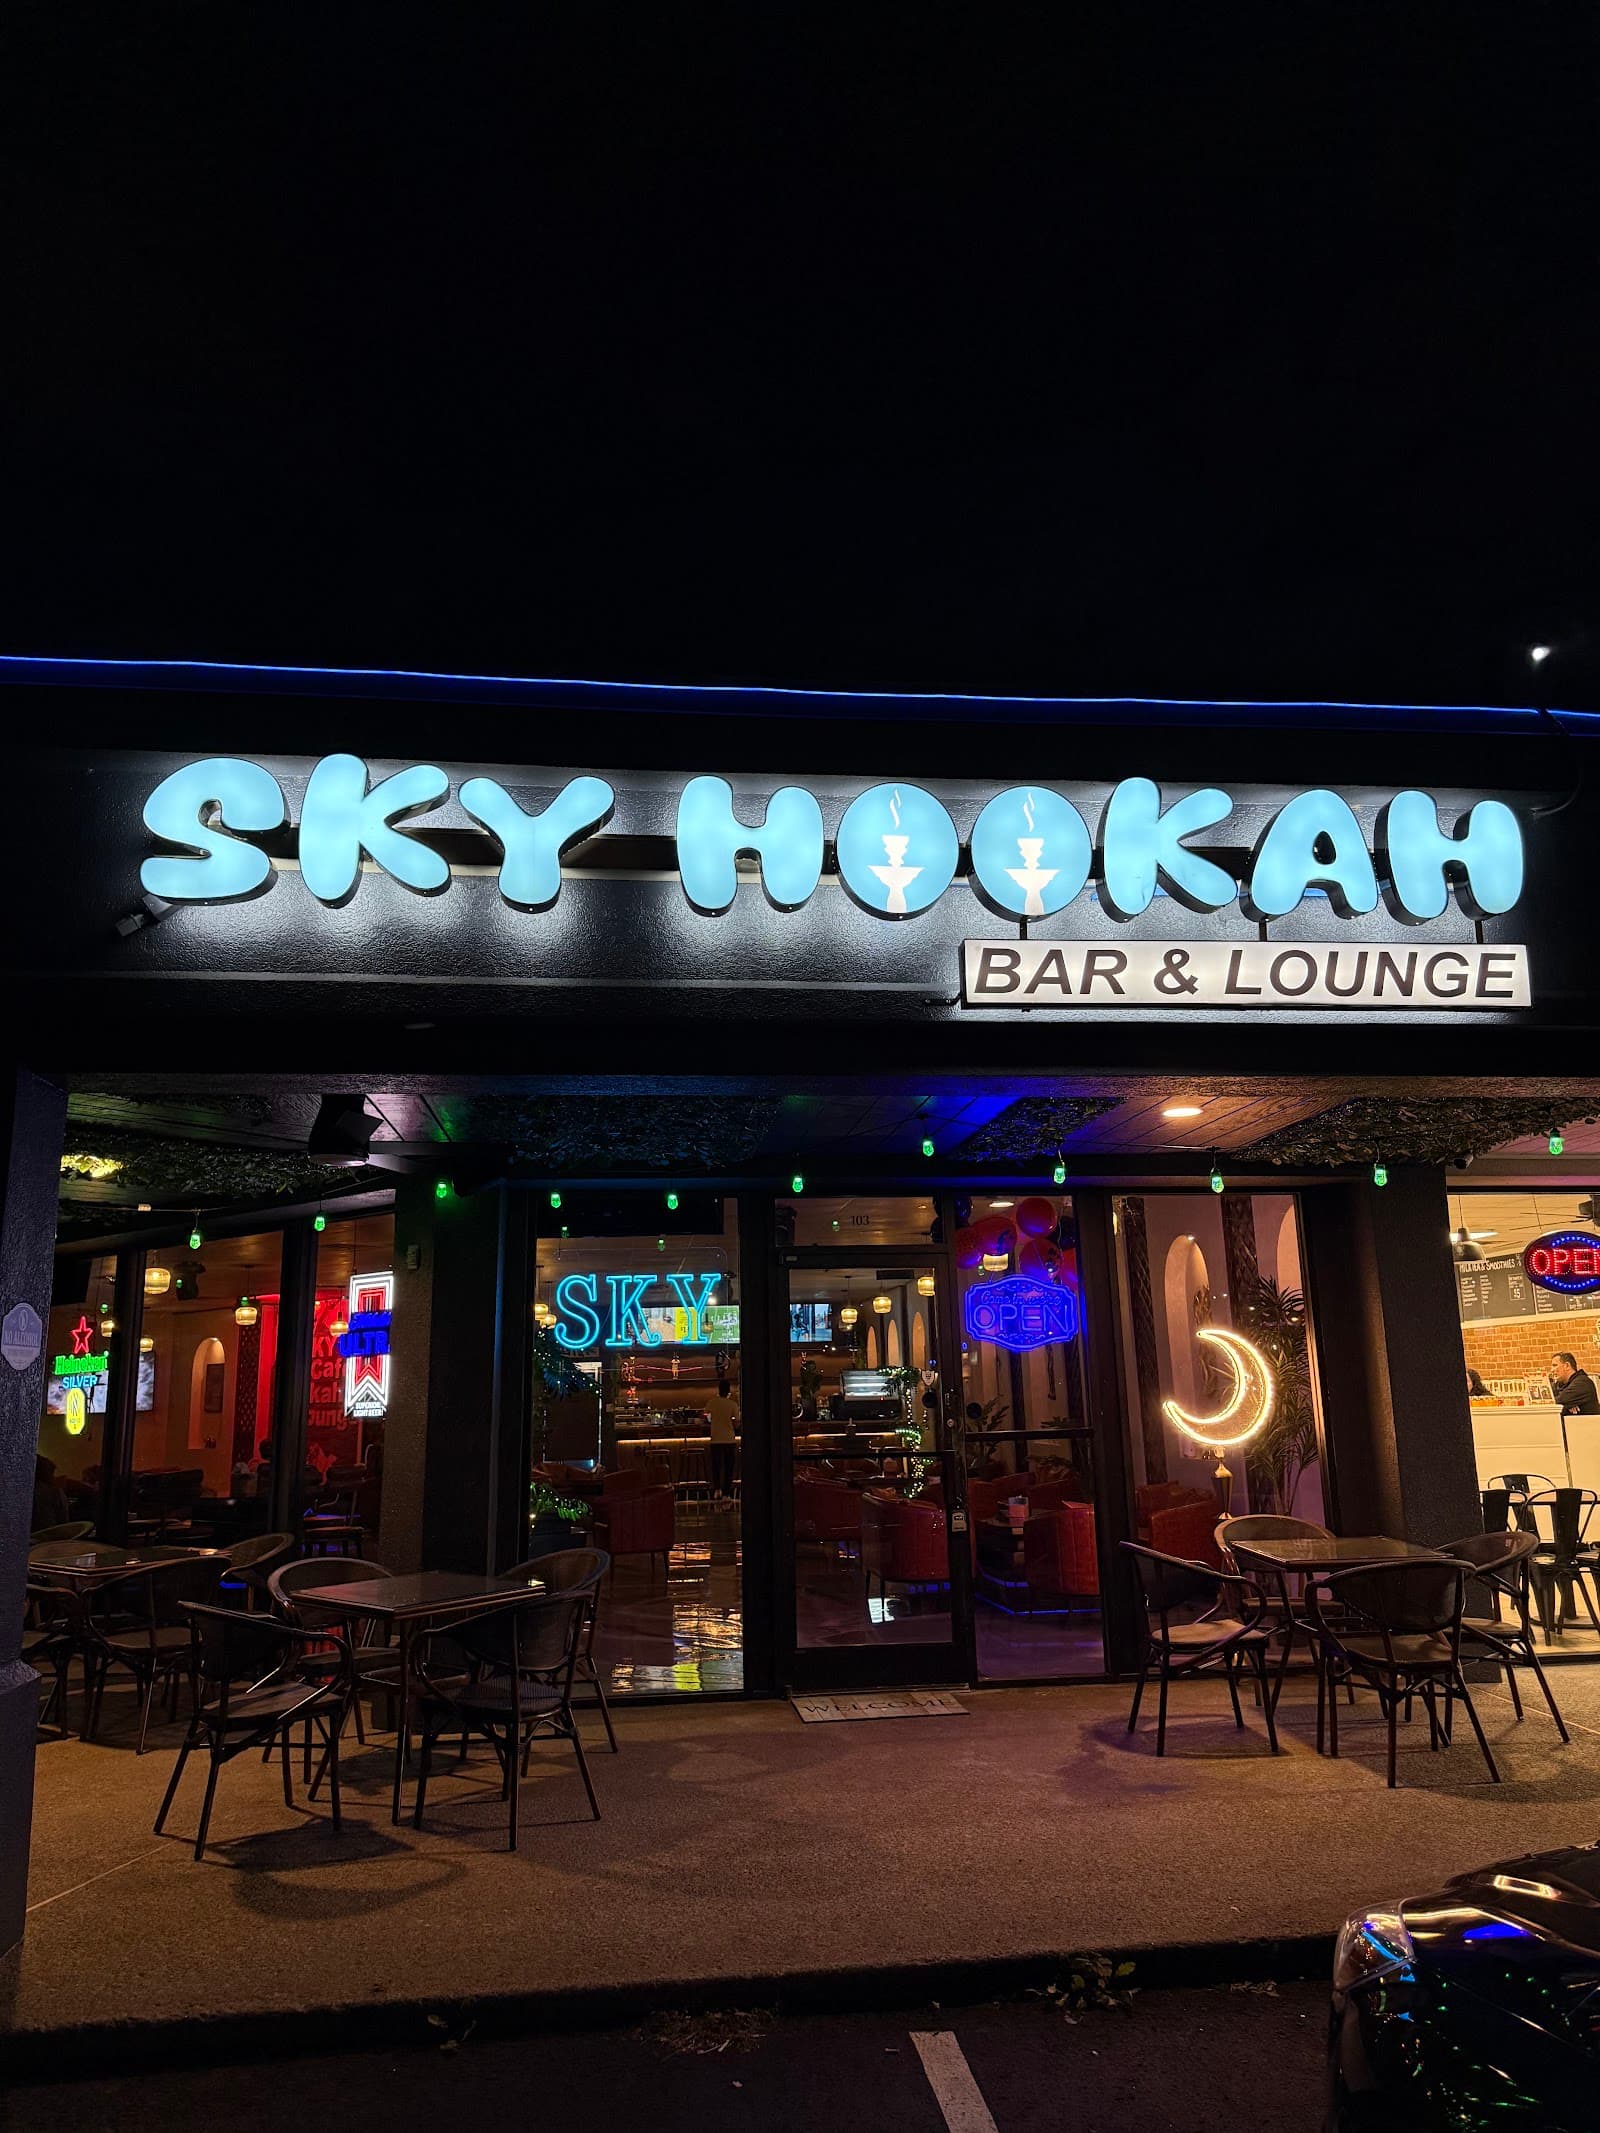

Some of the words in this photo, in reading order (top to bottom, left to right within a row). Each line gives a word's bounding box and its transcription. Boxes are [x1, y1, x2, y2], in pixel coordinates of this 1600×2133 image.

[140, 754, 615, 907] SKY
[676, 776, 1524, 918] HOOKAH
[974, 948, 1128, 995] BAR
[1153, 949, 1199, 995] &
[1224, 949, 1517, 998] LOUNGE
[851, 1215, 870, 1226] 103
[554, 1273, 722, 1350] SKY
[973, 1304, 1069, 1333] OPEN
[311, 1335, 338, 1358] KY
[339, 1330, 391, 1358] ULTR
[55, 1353, 108, 1375] Heineken
[62, 1375, 98, 1389] SILVER
[803, 1699, 956, 1713] WELCOME
